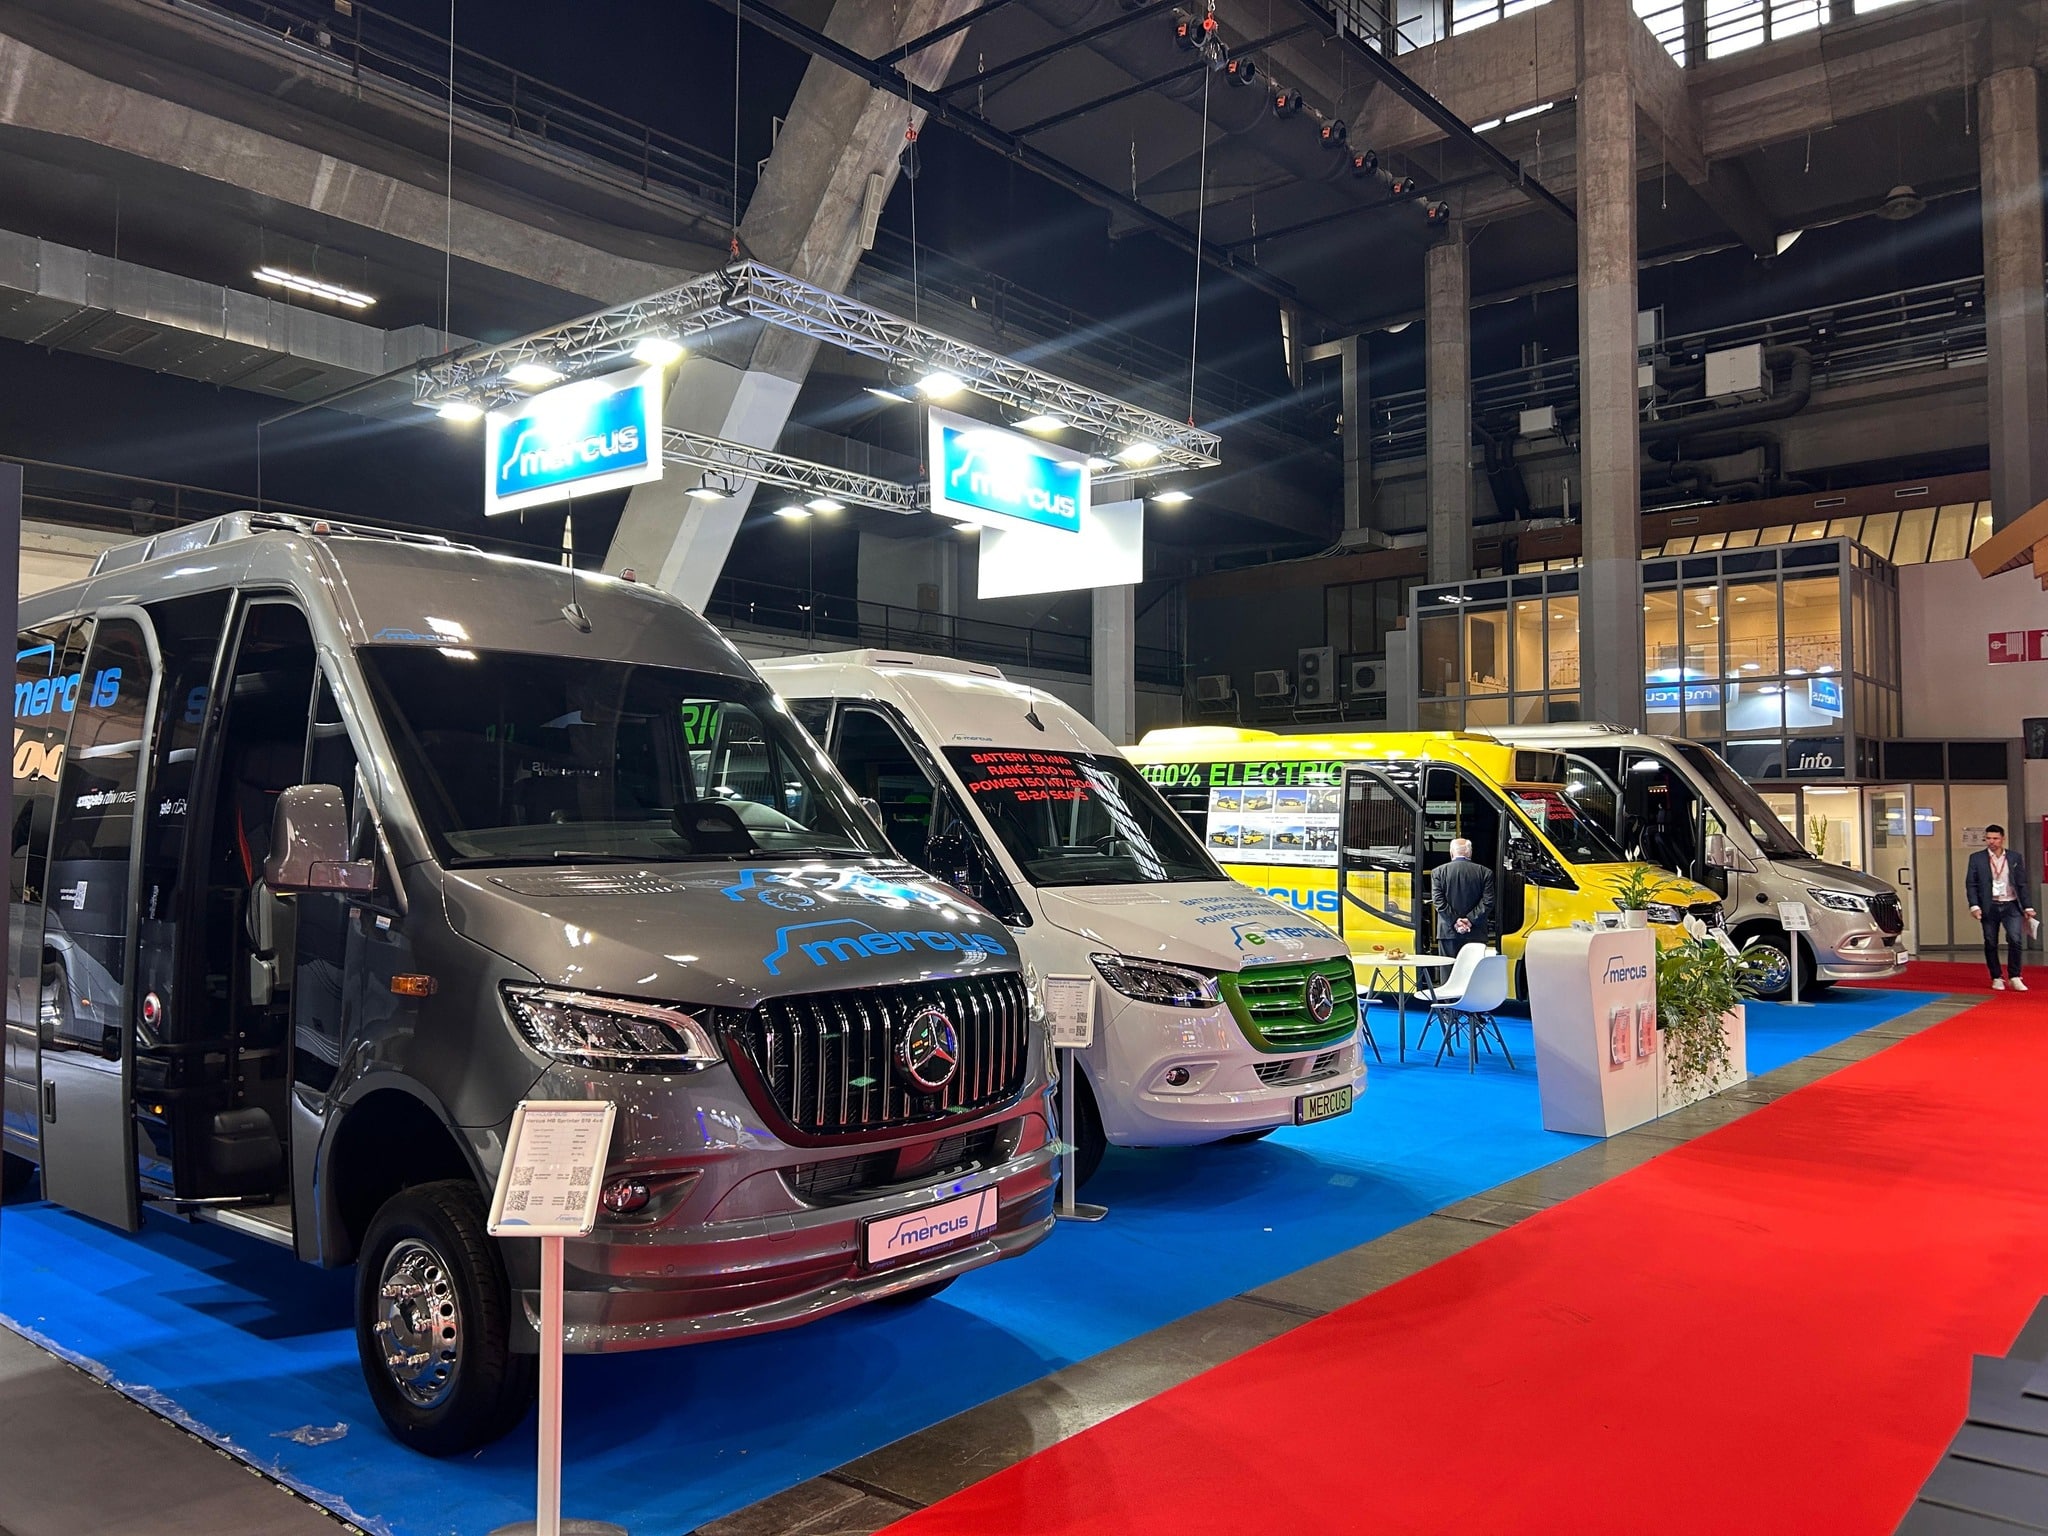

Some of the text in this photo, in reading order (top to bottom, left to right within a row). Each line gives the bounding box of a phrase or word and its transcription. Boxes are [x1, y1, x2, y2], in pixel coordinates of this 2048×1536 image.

[970, 472, 1076, 519] mcus
[971, 753, 1027, 764] BATTERY
[1030, 754, 1045, 764] 113
[1799, 752, 1833, 769] info
[987, 765, 1077, 777] RANGE 300 km
[1140, 761, 1345, 787] 100% ELECTRIC
[968, 778, 1023, 794] POWER
[1023, 778, 1045, 788] 150
[1014, 790, 1089, 801] 21-24 SEATS
[800, 929, 1008, 966] mercus
[1609, 965, 1647, 983] mercus
[1309, 1090, 1347, 1118] MERCUS
[901, 1215, 968, 1246] mercus
